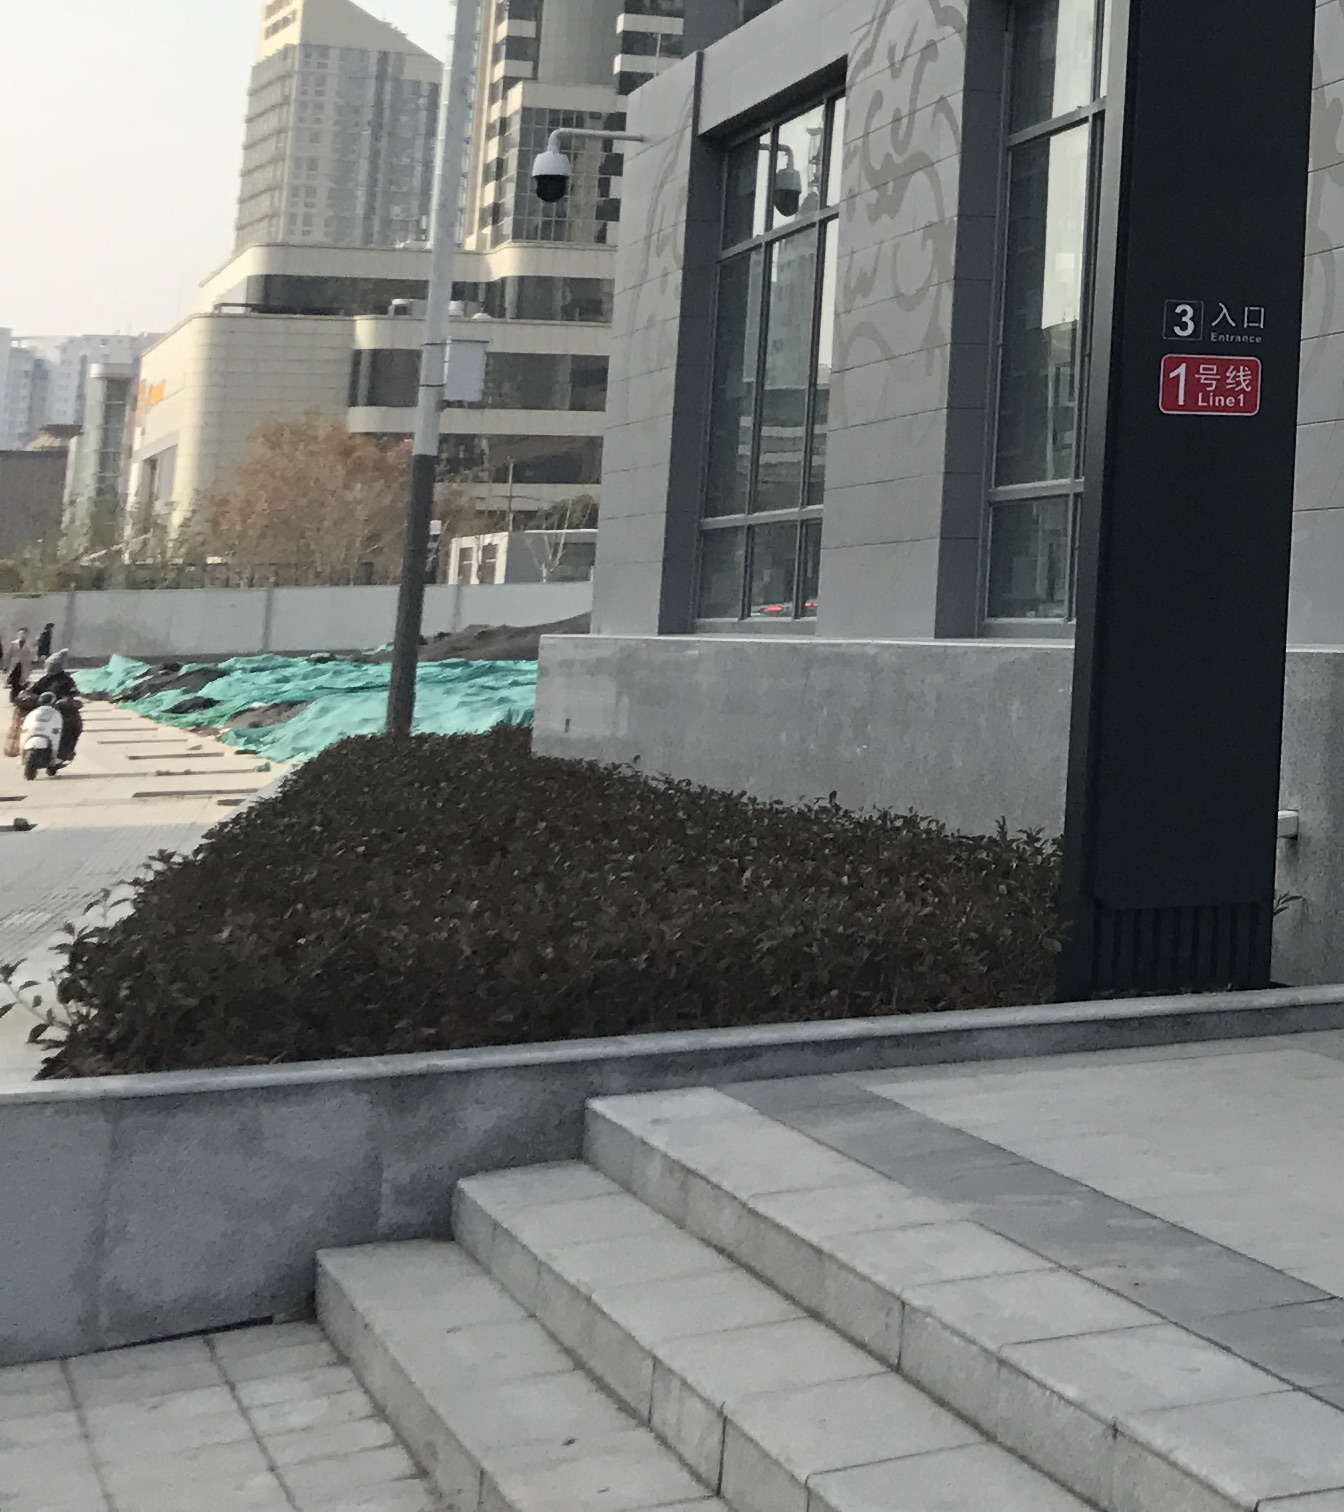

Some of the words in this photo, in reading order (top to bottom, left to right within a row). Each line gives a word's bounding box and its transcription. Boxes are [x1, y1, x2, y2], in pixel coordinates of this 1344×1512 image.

[1173, 304, 1195, 337] 3
[1211, 302, 1265, 329] 入口
[1210, 332, 1262, 343] Entrance
[1169, 362, 1252, 406] 1号线
[1198, 392, 1245, 407] Line1
